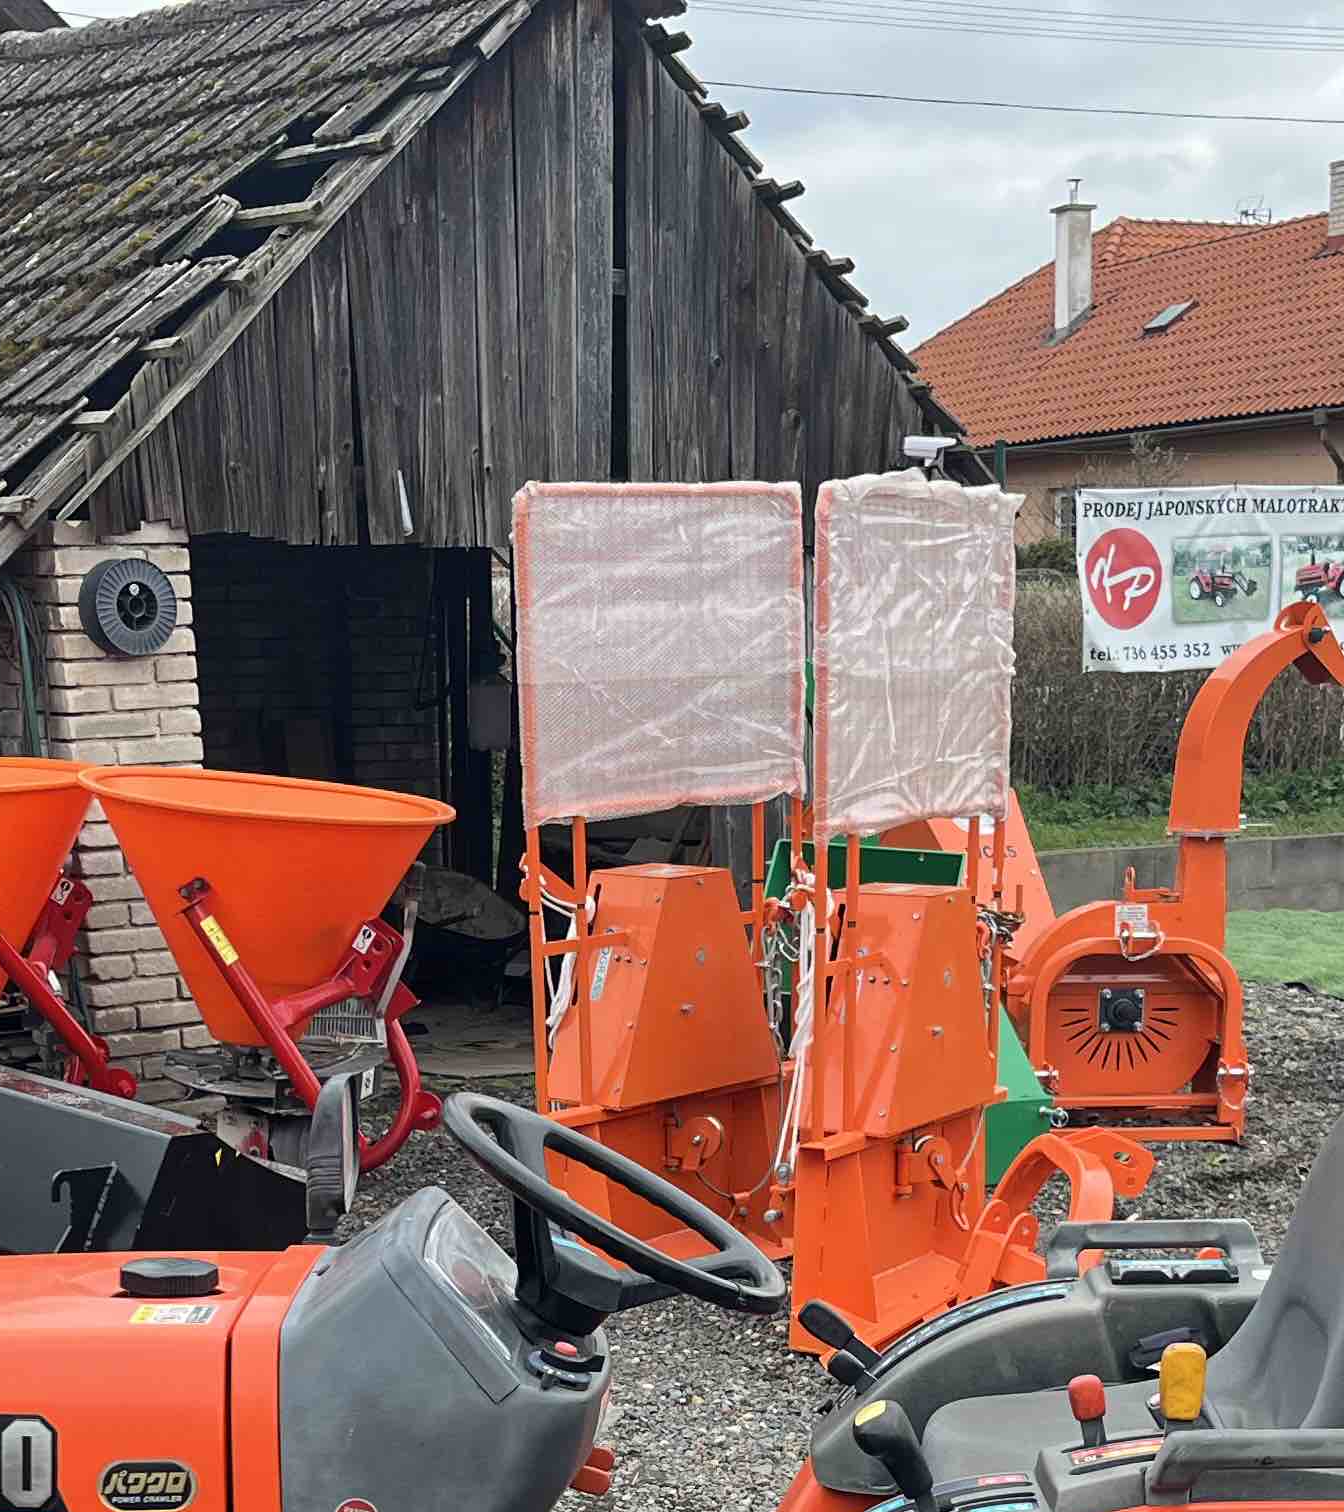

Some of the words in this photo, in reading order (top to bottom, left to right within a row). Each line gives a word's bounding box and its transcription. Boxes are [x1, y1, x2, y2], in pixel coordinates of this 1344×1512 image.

[1084, 502, 1143, 520] PRODEJ
[1122, 646, 1147, 661] 736
[1150, 643, 1177, 660] 455
[1183, 642, 1210, 658] 352
